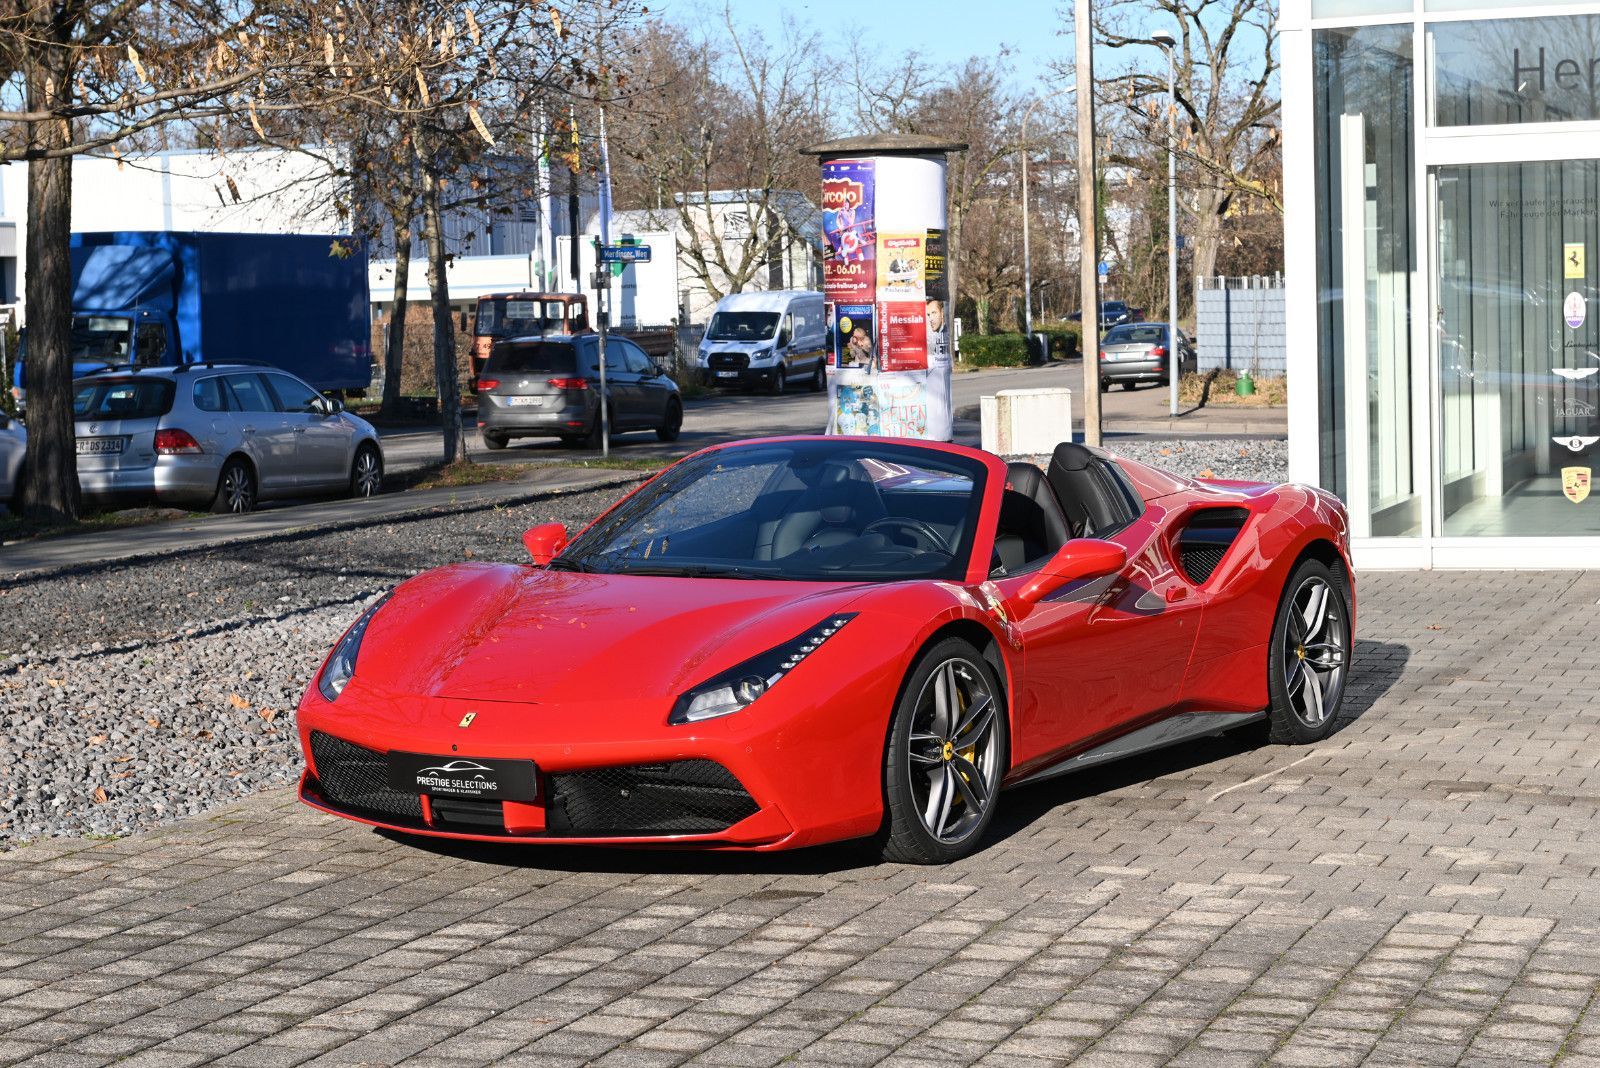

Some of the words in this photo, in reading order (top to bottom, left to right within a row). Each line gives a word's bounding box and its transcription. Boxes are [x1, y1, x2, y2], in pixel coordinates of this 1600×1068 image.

[635, 249, 648, 259] Weg
[890, 315, 923, 324] Messiah
[1555, 408, 1590, 416] JAGUAR
[416, 776, 450, 787] PRESTIGE
[452, 779, 497, 790] SELECTIONS
